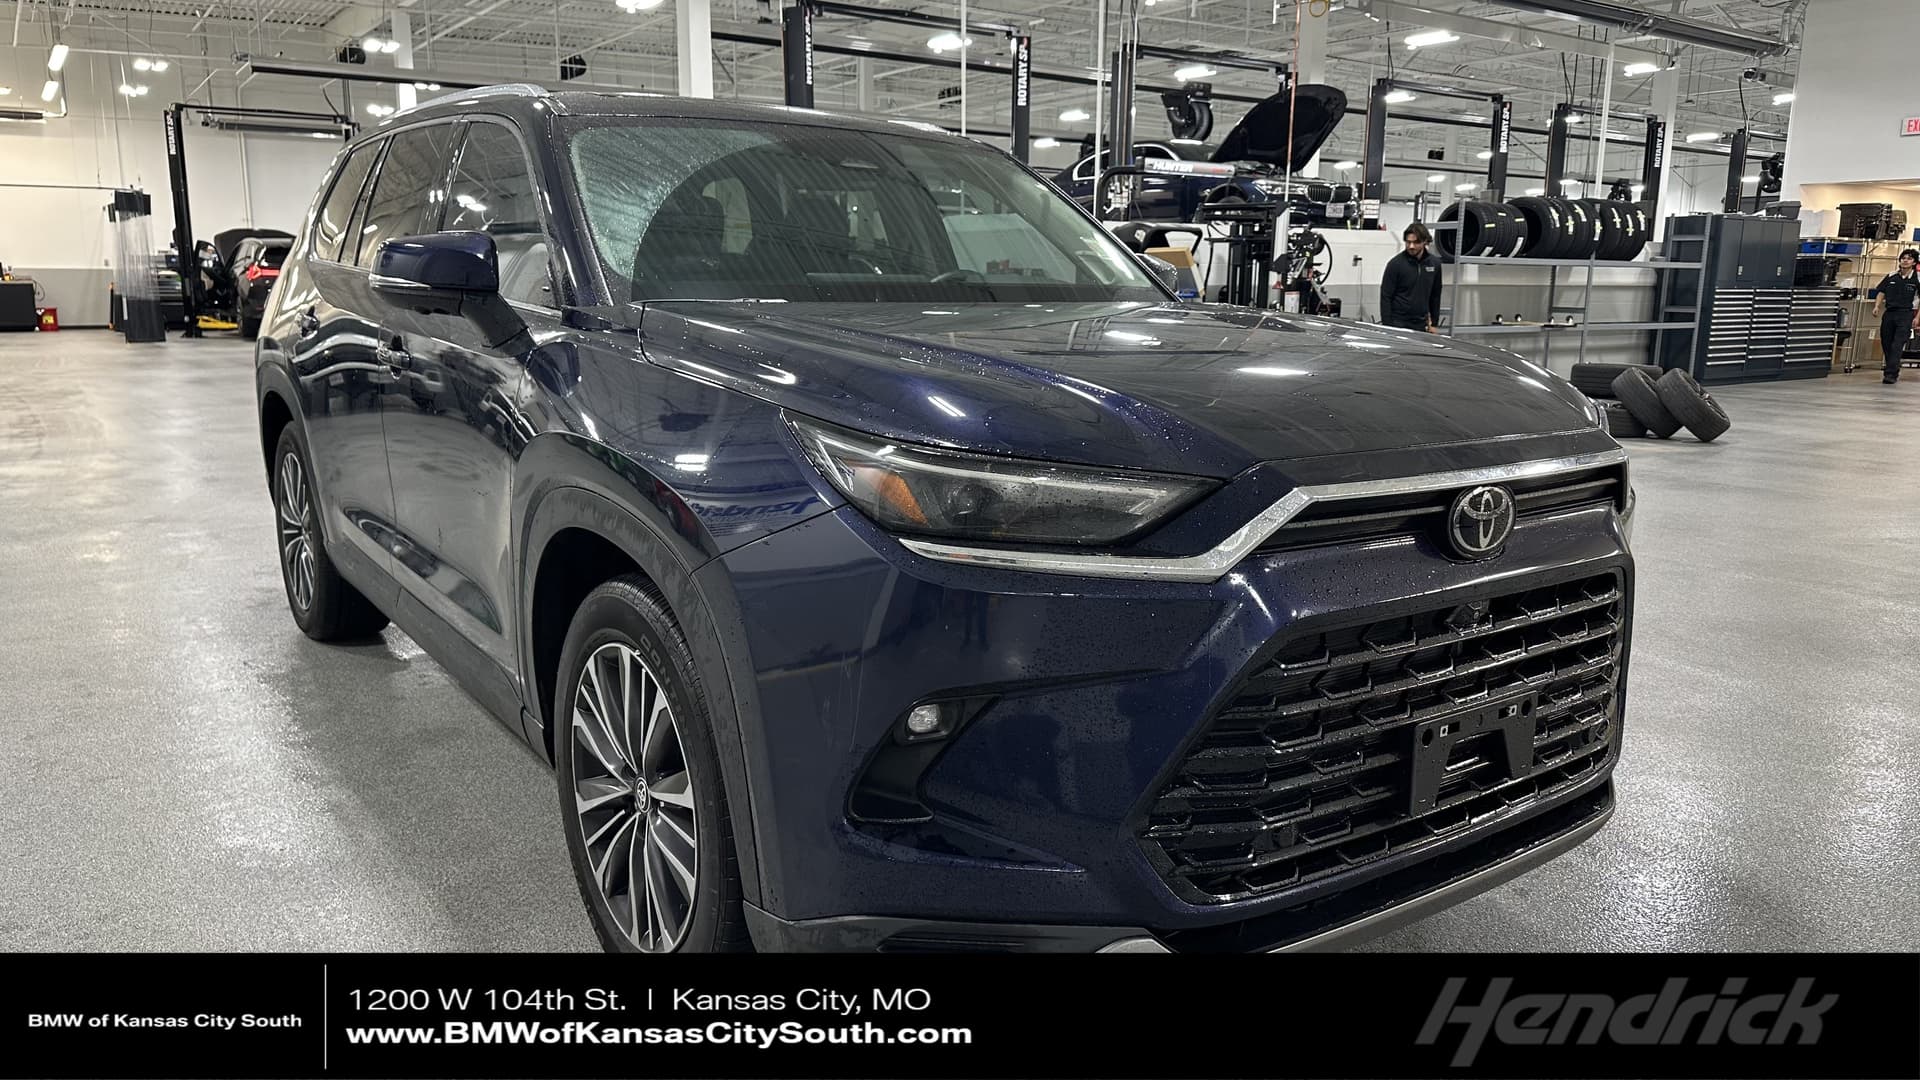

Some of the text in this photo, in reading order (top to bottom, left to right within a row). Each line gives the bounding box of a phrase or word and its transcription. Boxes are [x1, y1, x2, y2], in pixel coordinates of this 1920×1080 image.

[805, 35, 813, 86] ROTARY
[1017, 60, 1028, 107] ROTARY
[167, 126, 177, 155] ROTARY
[1499, 119, 1509, 153] ROTARY
[1907, 119, 1920, 132] EX
[1152, 160, 1195, 173] HUNTER
[1653, 138, 1663, 168] ROTARY
